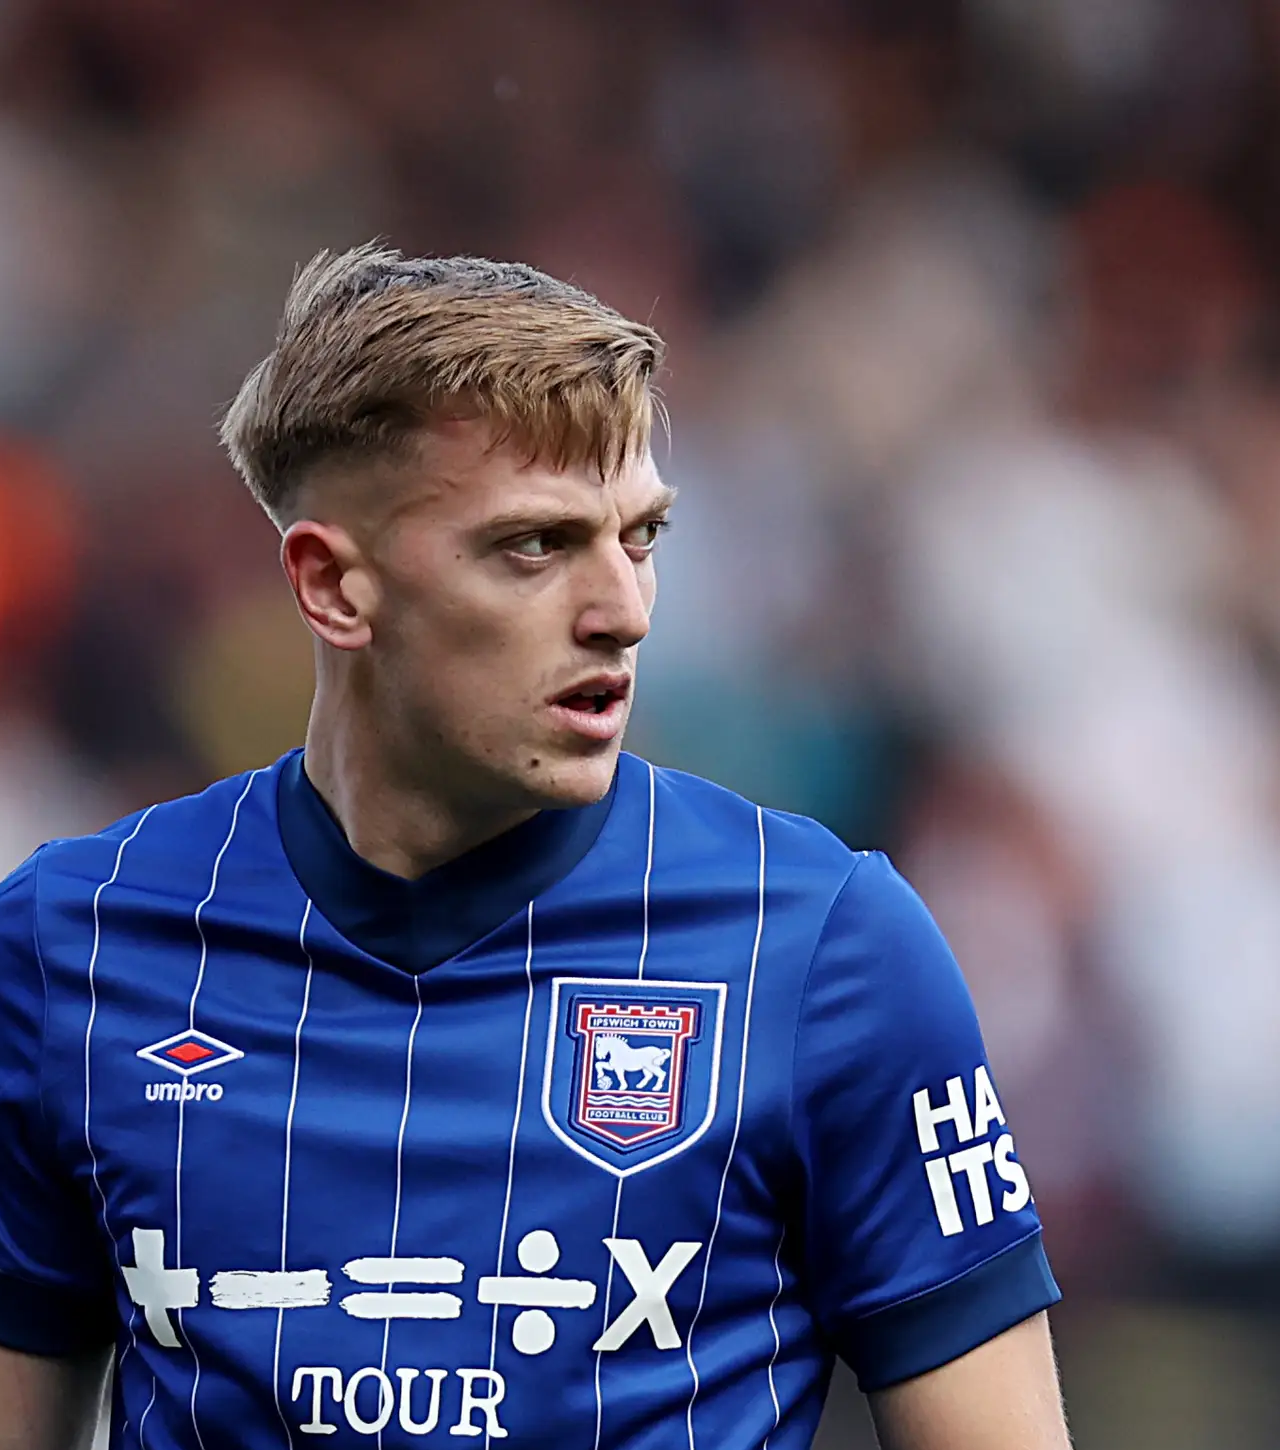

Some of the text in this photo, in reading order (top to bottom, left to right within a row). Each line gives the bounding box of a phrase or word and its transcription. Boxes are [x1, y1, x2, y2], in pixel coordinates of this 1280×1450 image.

[592, 1018, 677, 1030] IPSWICH TOWN
[145, 1081, 224, 1101] umbro
[913, 1065, 1006, 1154] HA
[590, 1110, 665, 1121] FOOTBALL CLUB
[925, 1133, 1035, 1237] ITS
[292, 1366, 508, 1438] TOUR
